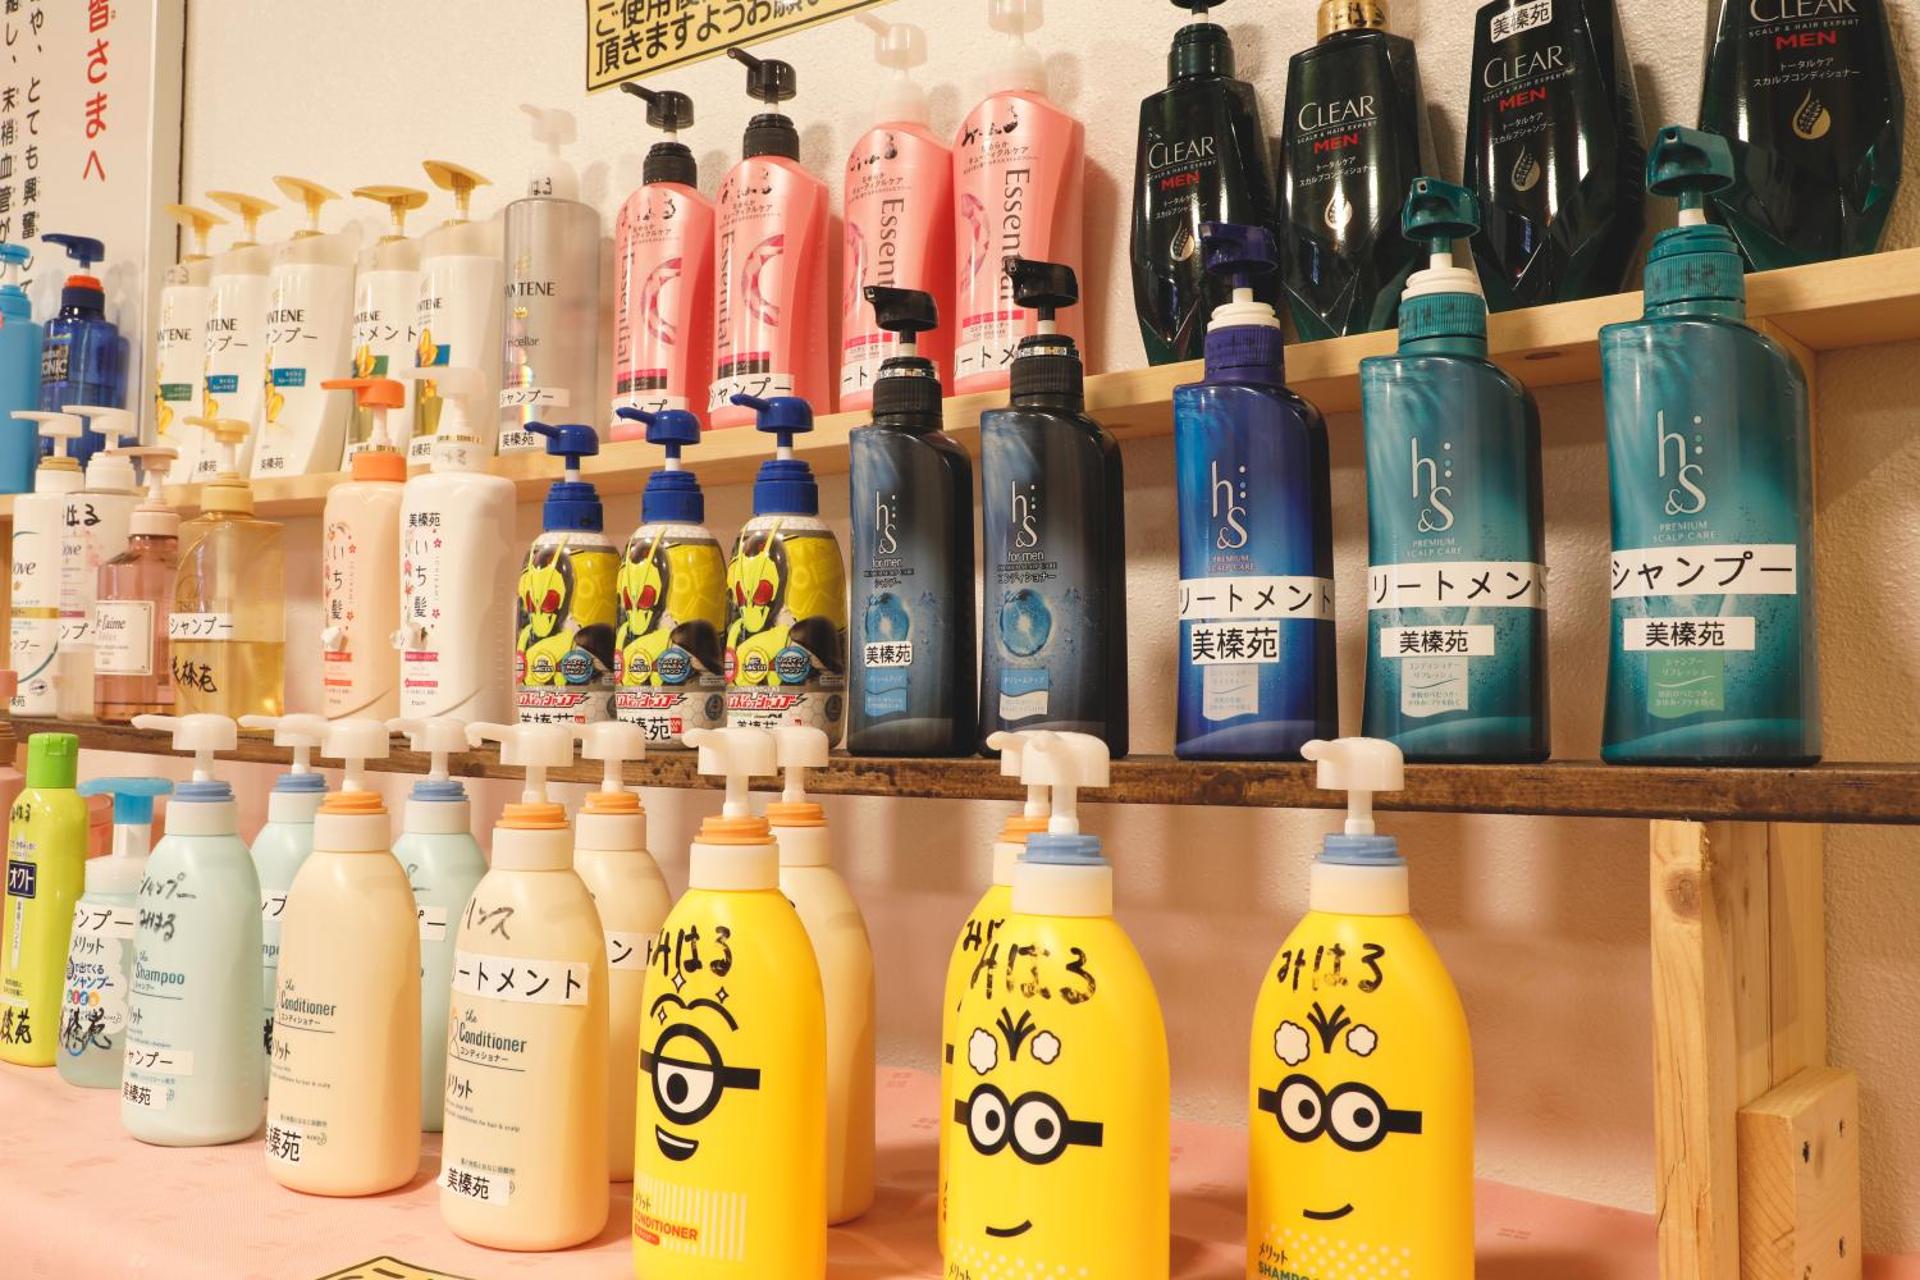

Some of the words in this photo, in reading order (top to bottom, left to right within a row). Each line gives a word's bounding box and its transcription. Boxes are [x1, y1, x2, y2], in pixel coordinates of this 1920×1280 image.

[1492, 4, 1550, 39] 美榛苑
[1749, 27, 1781, 38] SCALP
[1776, 31, 1838, 51] MEN
[1485, 45, 1565, 88] CLEAR
[1780, 58, 1834, 72] トータルケア
[1753, 69, 1862, 89] スカルプコンディショナー
[1500, 87, 1548, 112] MEN
[1298, 95, 1375, 131] CLEAR
[1503, 112, 1544, 131] トータルケア
[1148, 136, 1215, 169] CLEAR
[1313, 132, 1358, 154] MEN
[1160, 171, 1201, 192] MEN
[716, 230, 736, 350] Essential
[408, 512, 441, 528] 美榛苑
[1659, 521, 1709, 532] PREMIUM
[1413, 538, 1456, 548] PREMIUM
[1688, 530, 1717, 540] CARE
[1022, 551, 1044, 562] men
[331, 545, 345, 620] いち髪
[413, 538, 428, 619] いち髪
[1612, 551, 1793, 590] シャンプー
[170, 616, 233, 635] シャンプー
[1645, 621, 1726, 648] 美榛苑
[865, 644, 912, 664] 美榛苑
[1192, 626, 1278, 661] 美榛苑
[1400, 630, 1469, 653] 美榛苑
[9, 867, 35, 892] オクト
[135, 961, 185, 987] Shampoo
[280, 989, 337, 1017] Conditioner
[458, 1021, 528, 1055] Conditioner
[460, 1046, 510, 1064] コンディショナー
[265, 1126, 302, 1162] 榛苑
[446, 1167, 491, 1201] 美榛苑
[1259, 1241, 1289, 1266] メリット
